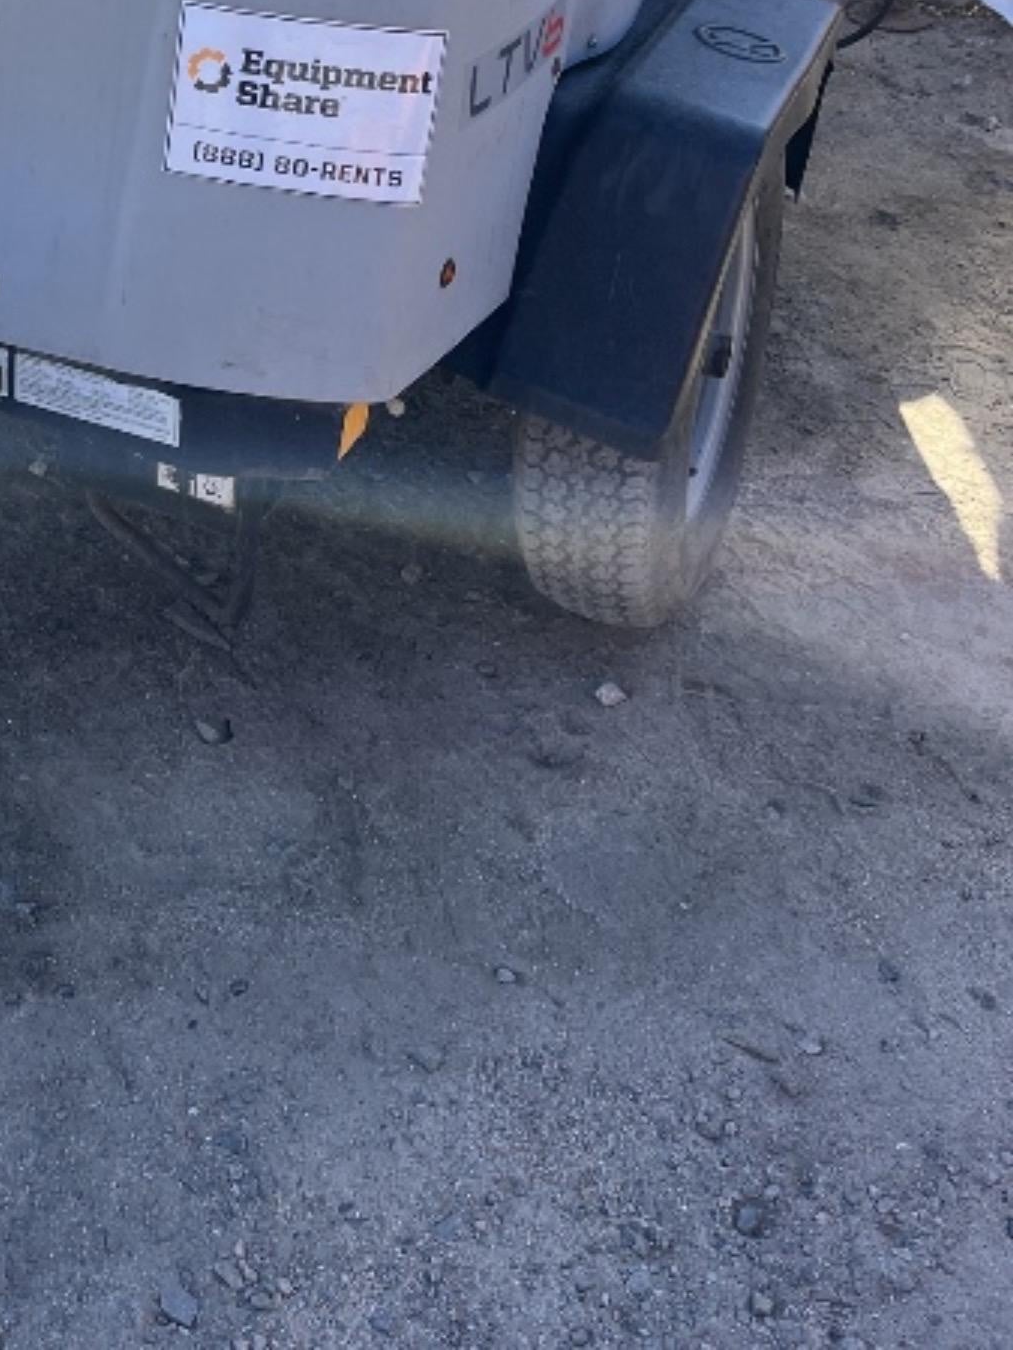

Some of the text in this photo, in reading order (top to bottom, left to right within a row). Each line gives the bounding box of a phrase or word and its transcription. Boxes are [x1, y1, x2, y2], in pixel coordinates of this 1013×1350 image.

[240, 49, 433, 94] Equipment
[236, 80, 340, 118] Share
[193, 141, 403, 188] (888) 80-RENTS
